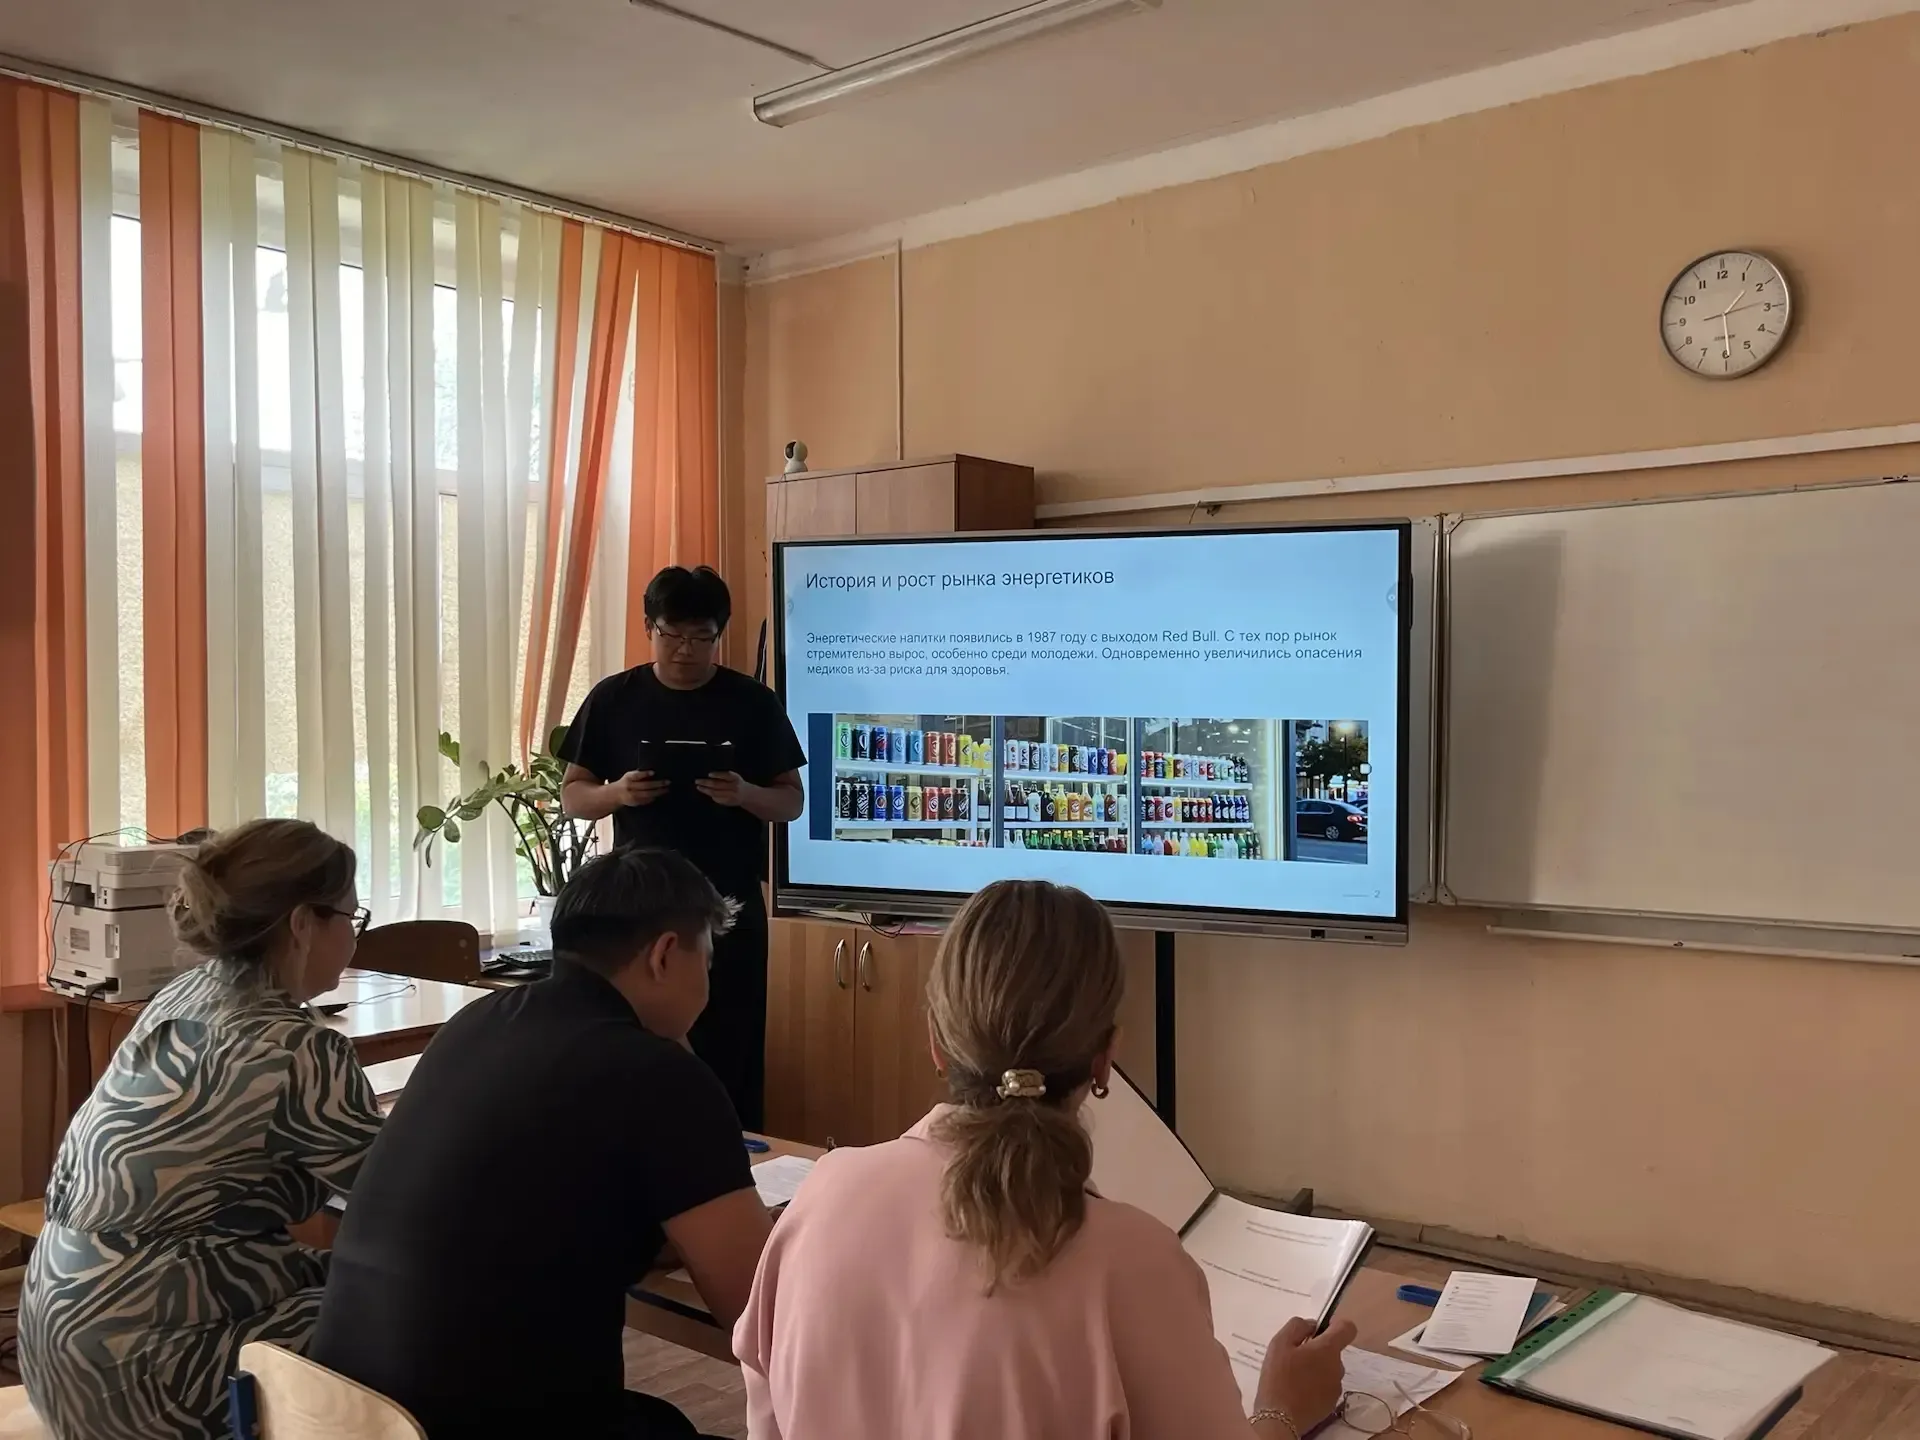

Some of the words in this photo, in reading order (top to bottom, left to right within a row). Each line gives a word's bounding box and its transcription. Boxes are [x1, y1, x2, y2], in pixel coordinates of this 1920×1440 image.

[1717, 270, 1728, 280] 12
[1741, 272, 1746, 281] 1
[1699, 280, 1706, 289] 11
[1755, 283, 1764, 292] 2
[1684, 295, 1696, 305] 10
[1763, 302, 1771, 312] 3
[1679, 318, 1687, 327] 9
[1757, 323, 1765, 332] 4
[1685, 336, 1693, 345] 8
[1743, 341, 1751, 350] 5
[1700, 347, 1708, 357] 7
[1722, 350, 1730, 359] 6
[806, 573, 876, 592] История
[882, 575, 892, 588] и
[898, 574, 936, 591] рост
[942, 573, 996, 590] рынка
[1002, 571, 1114, 589] энергетиков
[806, 632, 897, 645] Энергетические
[900, 633, 946, 643] напитки
[949, 633, 1012, 643] появились
[1016, 633, 1024, 642] в
[1028, 631, 1056, 642] 1987
[1060, 633, 1087, 645] году
[1090, 633, 1098, 642] с
[1101, 633, 1158, 644] выходом
[1162, 630, 1188, 642] Red
[1192, 630, 1220, 642] Bull.
[1224, 629, 1235, 642] С
[1239, 632, 1260, 641] тех
[1265, 632, 1290, 644] пор
[1294, 631, 1338, 644] рынок
[806, 649, 886, 661] стремительно
[889, 649, 928, 661] вырос,
[931, 647, 988, 659] особенно
[991, 649, 1027, 661] среди
[1031, 649, 1098, 660] молодежи.
[1101, 647, 1200, 661] Одновременно
[1204, 648, 1291, 661] увеличились
[1295, 648, 1362, 659] опасения
[807, 665, 854, 675] медиков
[857, 665, 886, 675] из-за
[889, 665, 922, 677] риска
[925, 665, 948, 675] для
[951, 665, 1010, 677] здоровья.
[1374, 889, 1381, 899] 2
